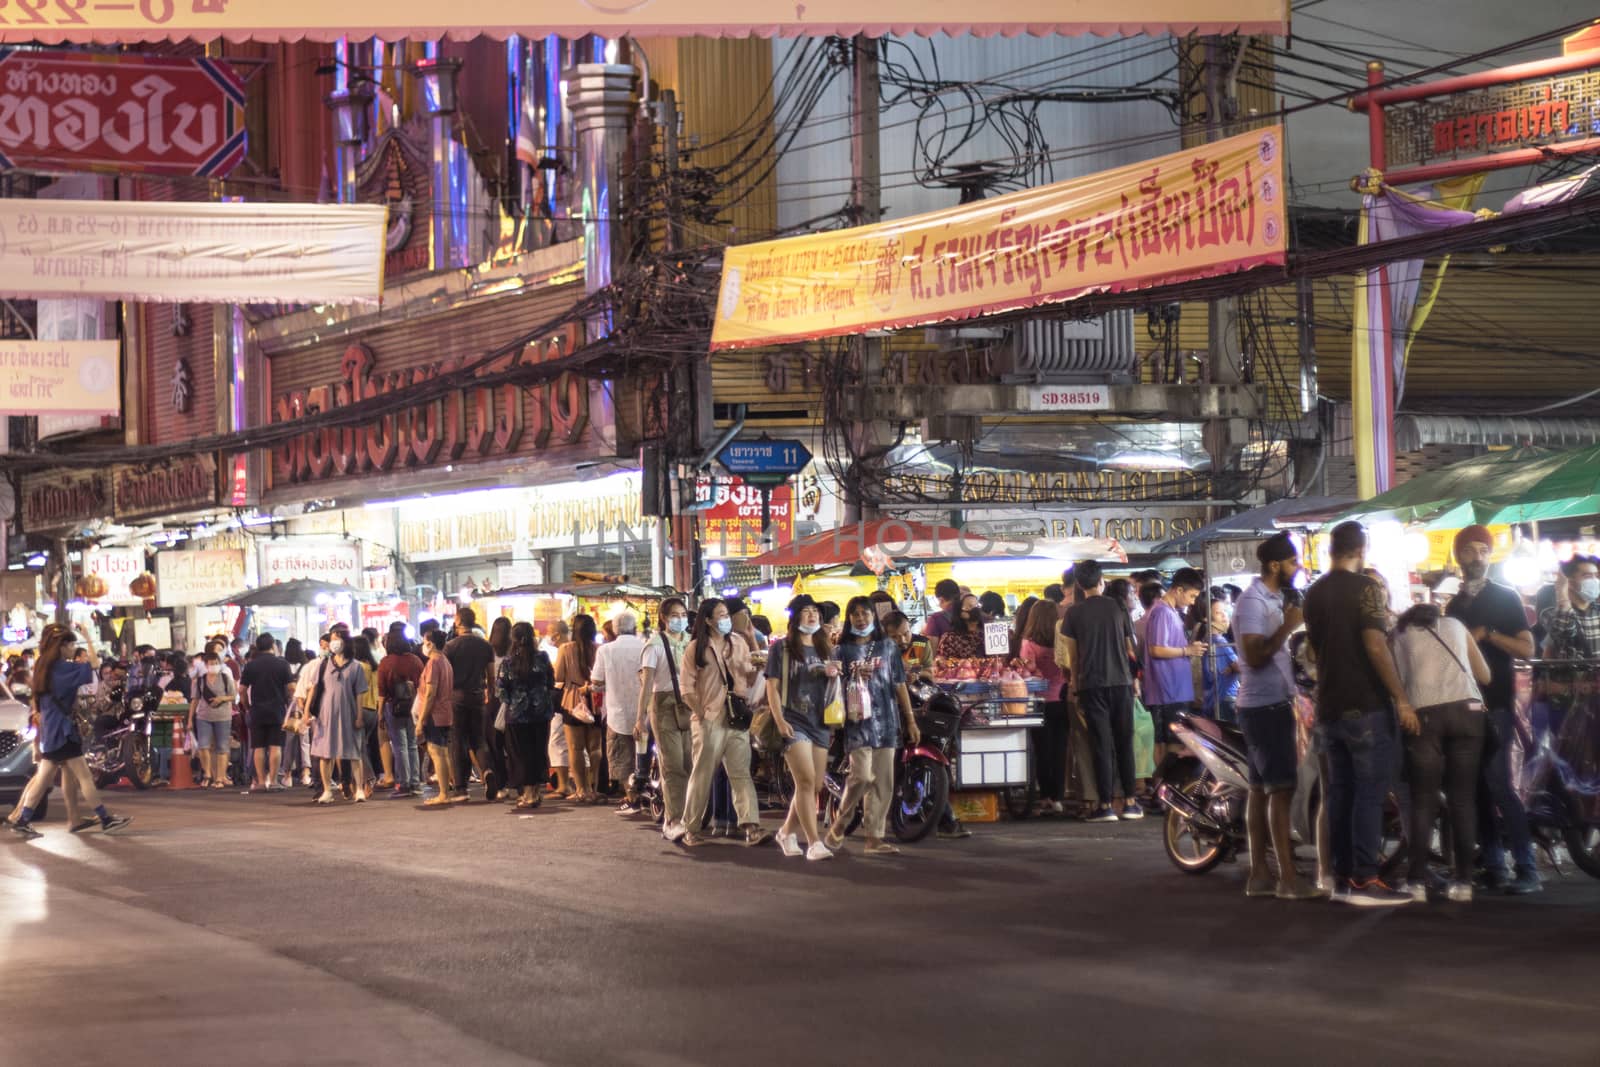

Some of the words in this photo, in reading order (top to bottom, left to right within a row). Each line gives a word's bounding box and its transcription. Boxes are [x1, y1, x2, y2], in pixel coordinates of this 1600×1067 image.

[6, 62, 117, 96] ห้างทอง
[1434, 86, 1569, 152] ตลาดเก่า
[729, 446, 773, 458] เยาวราช
[783, 447, 798, 465] 11
[1106, 518, 1167, 542] GOLD
[988, 633, 1008, 649] 100
